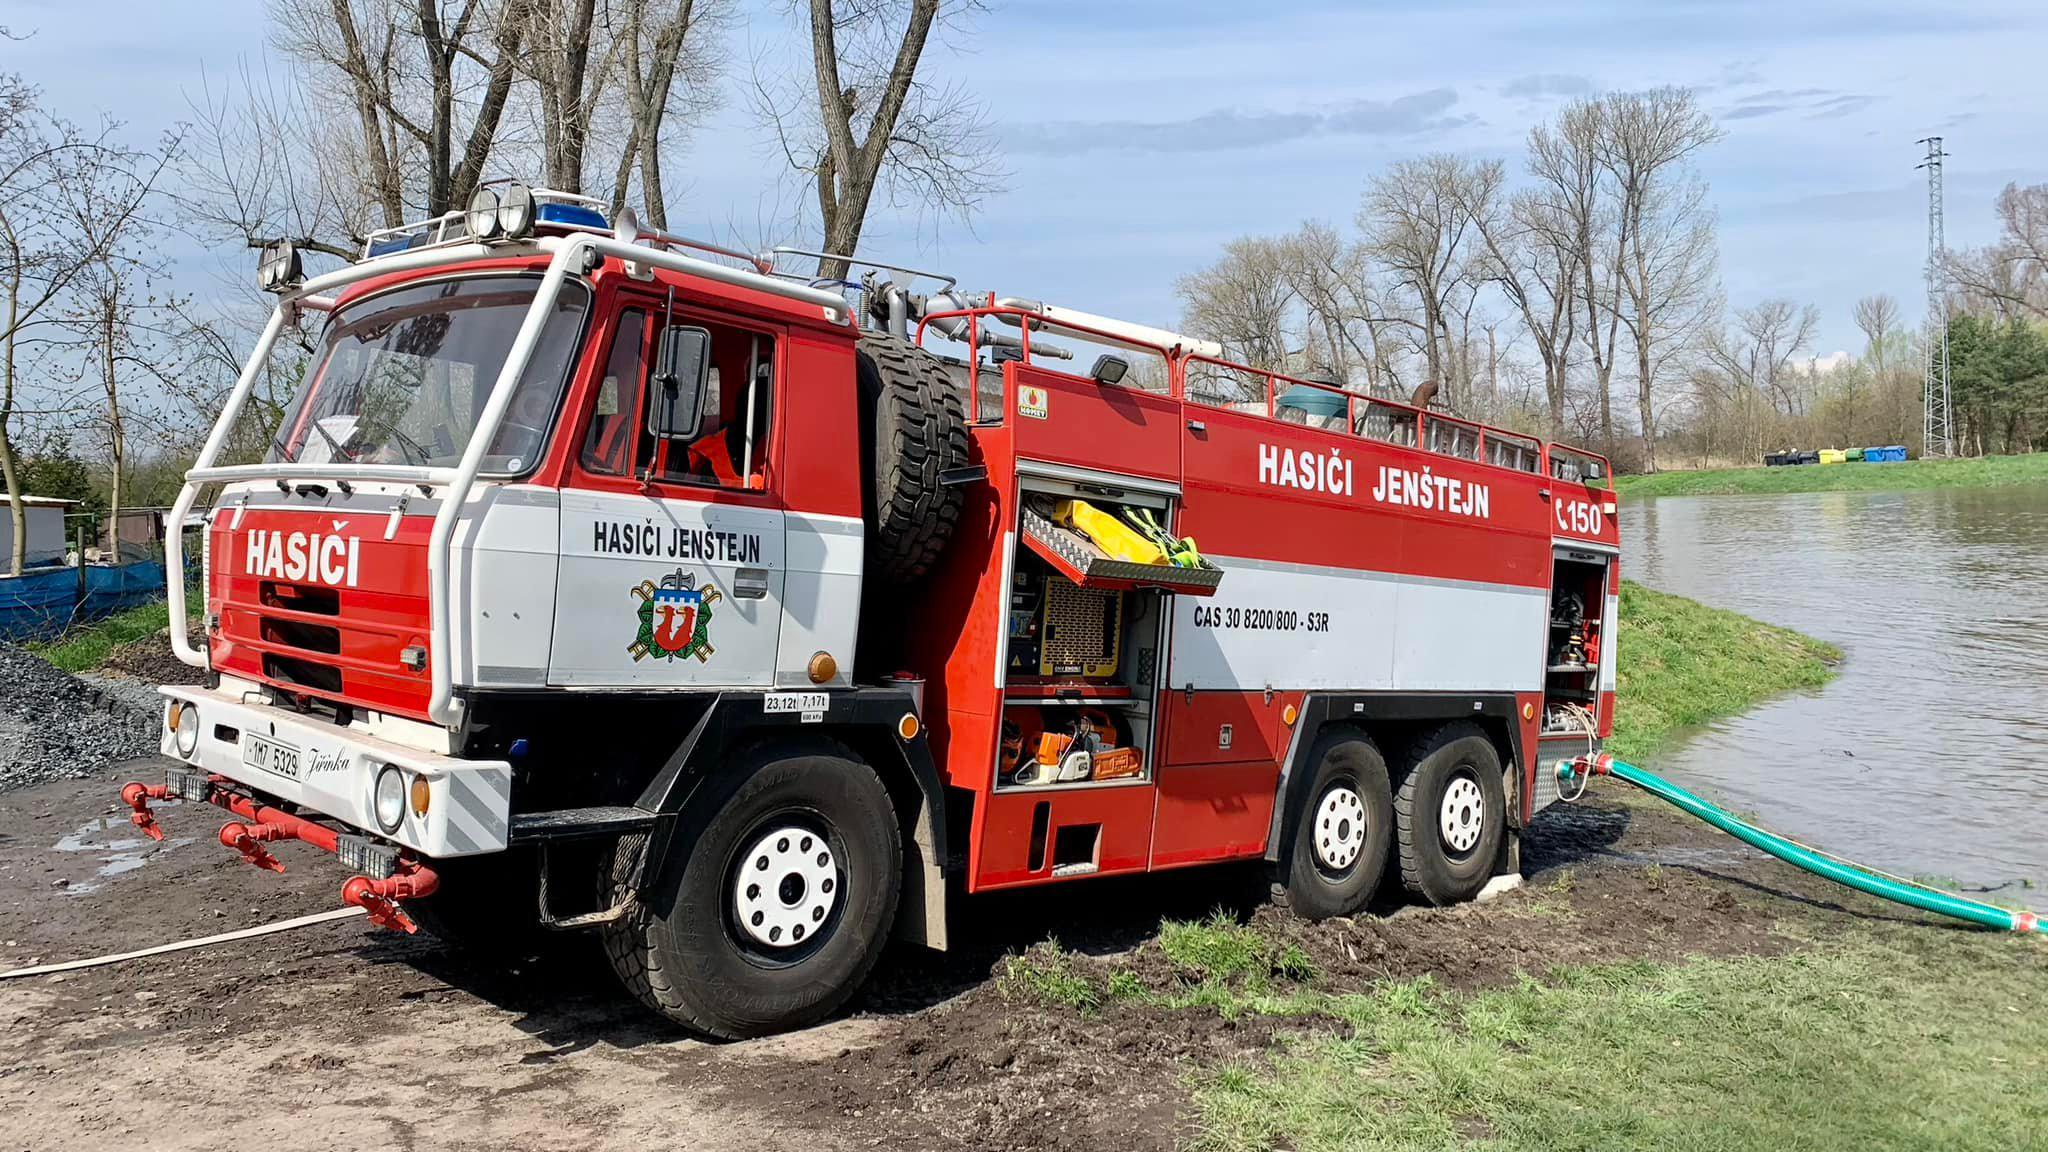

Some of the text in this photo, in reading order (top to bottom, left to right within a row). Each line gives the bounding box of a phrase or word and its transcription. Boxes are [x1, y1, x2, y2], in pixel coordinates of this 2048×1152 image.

[1258, 443, 1489, 518] HASIČI JENŠTEJN
[1567, 499, 1601, 535] 150
[246, 519, 360, 587] HASIČI
[594, 518, 760, 563] HASIČI JENŠTEJN
[1194, 605, 1221, 627] CAS
[1225, 607, 1240, 628] 30
[1244, 608, 1297, 631] 8200/800
[1307, 612, 1329, 632] S3R
[767, 695, 825, 711] 23,12t 7,17t
[254, 741, 298, 777] 1M7 5329
[304, 745, 350, 781] Jiřinka
